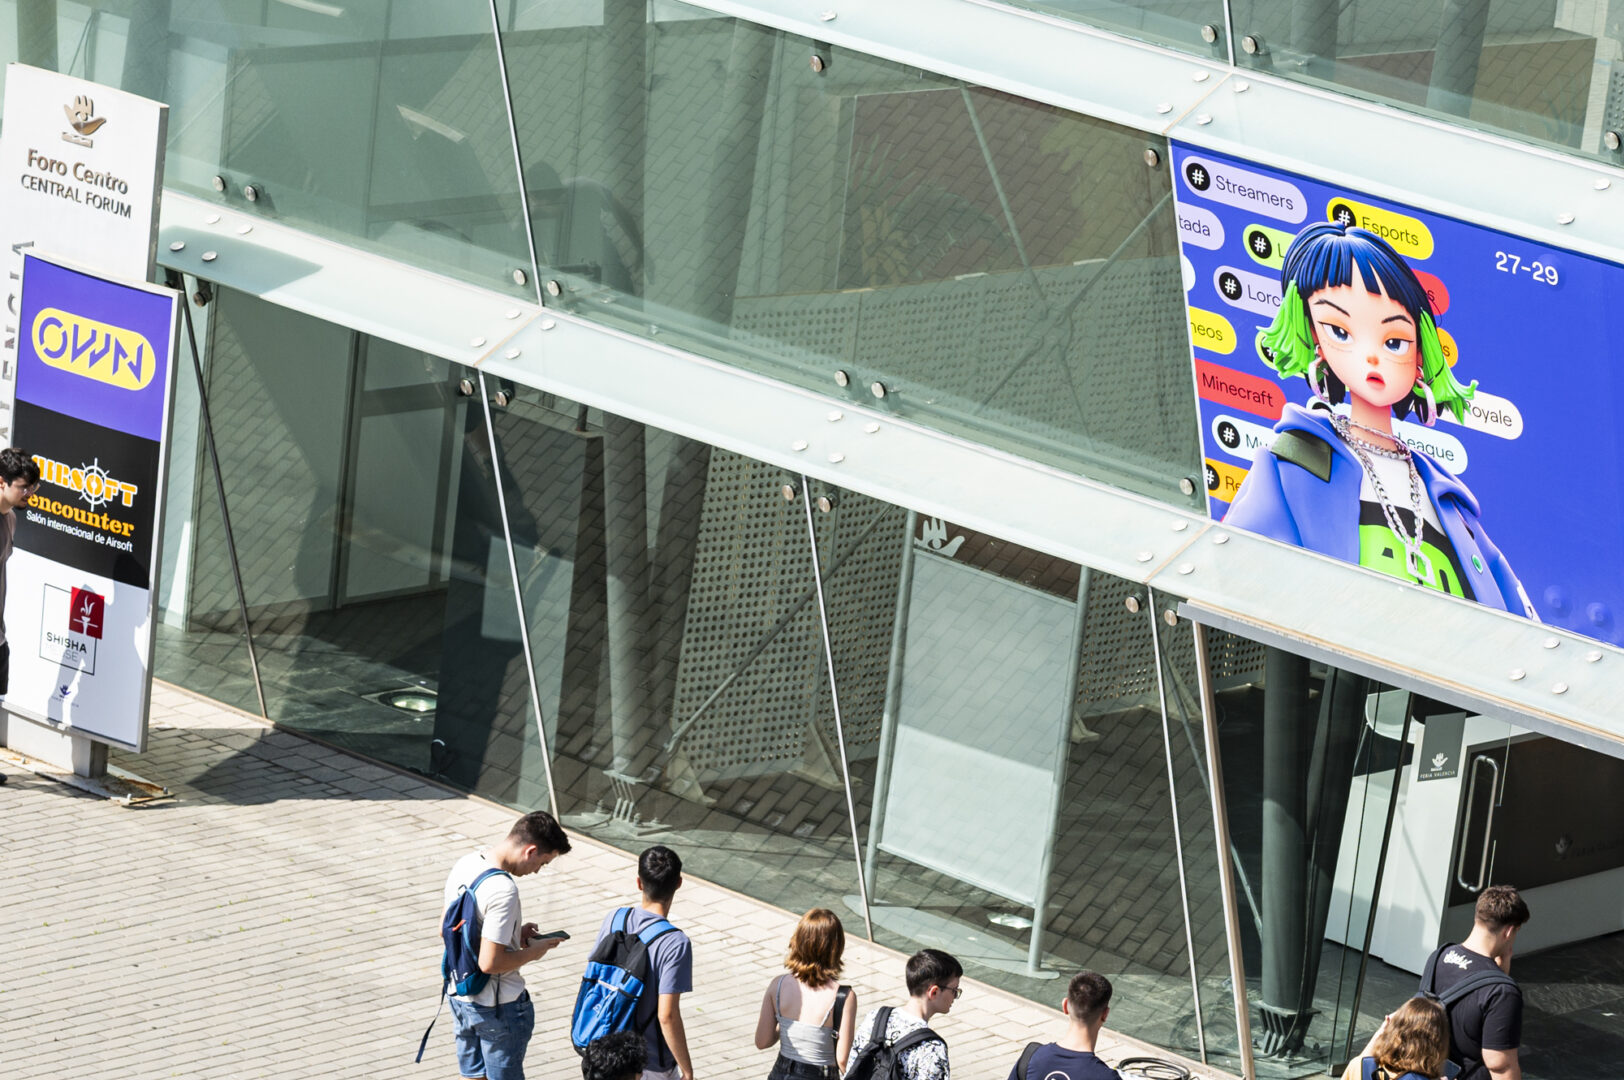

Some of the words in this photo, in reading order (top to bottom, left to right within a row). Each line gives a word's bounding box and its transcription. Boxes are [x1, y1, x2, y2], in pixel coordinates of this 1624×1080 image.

[27, 148, 68, 177] Foro
[72, 162, 129, 195] Centro
[20, 174, 82, 205] CENTRAL
[85, 192, 132, 219] FORUM
[1216, 174, 1294, 212] Streamers
[1495, 250, 1560, 286] 27-29
[1247, 284, 1282, 308] Lorc
[38, 315, 145, 384] OWN
[1190, 320, 1224, 342] neos
[1201, 371, 1274, 408] Minecraft
[26, 510, 46, 526] Salón
[47, 516, 94, 542] internacional
[94, 531, 105, 544] de
[105, 534, 134, 552] Airsoft
[27, 494, 135, 537] encounter
[46, 631, 87, 654] SHISHA
